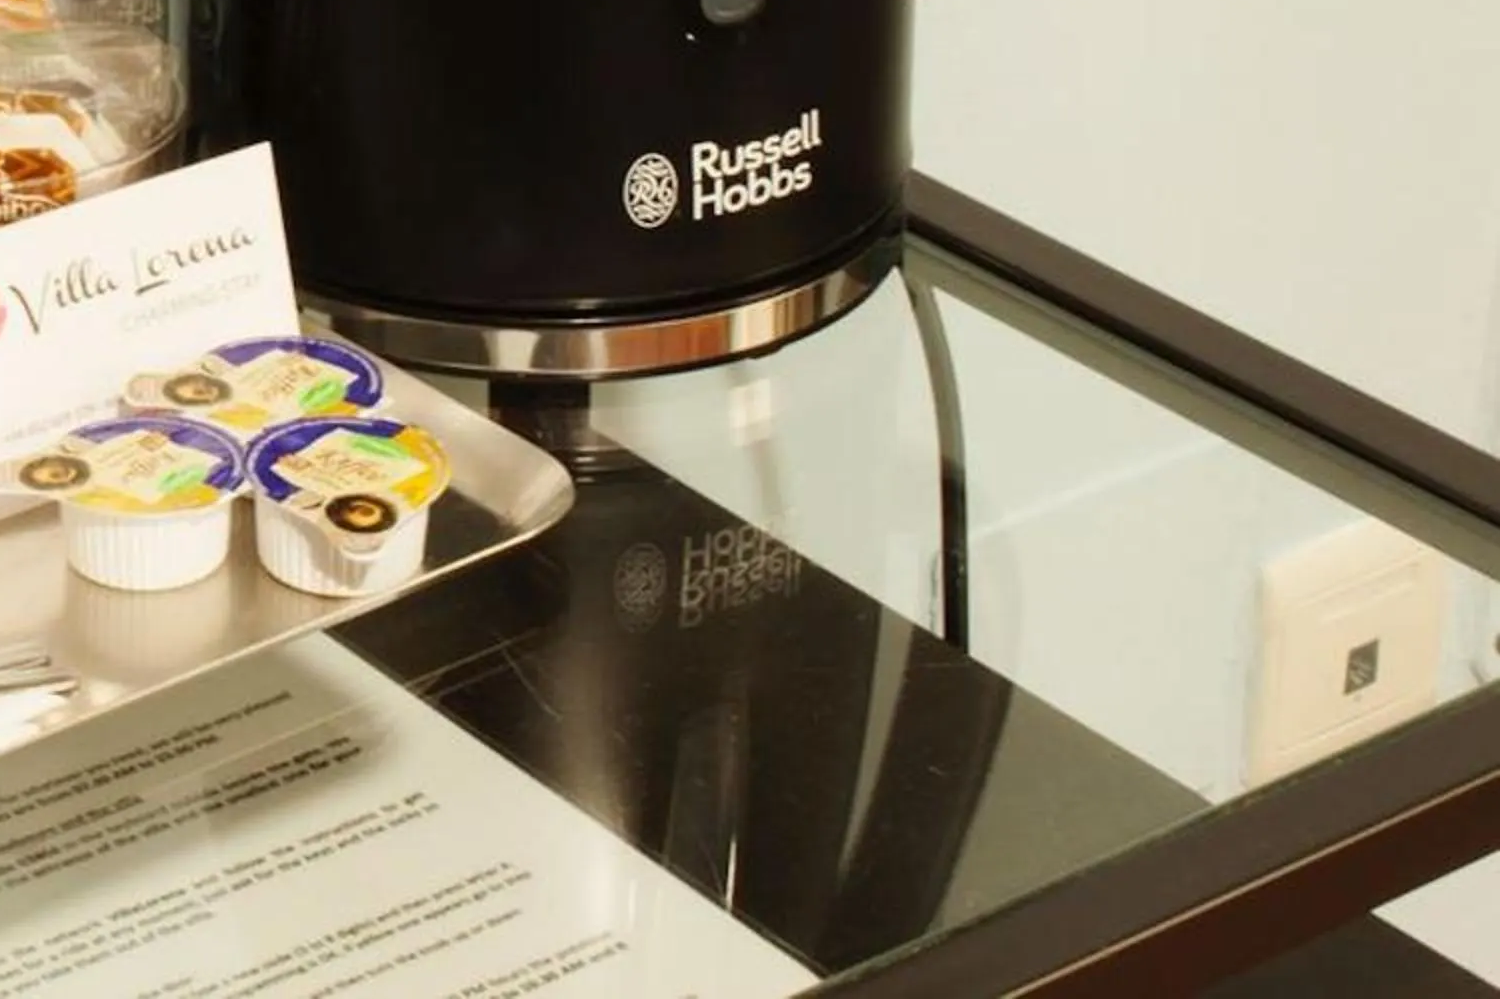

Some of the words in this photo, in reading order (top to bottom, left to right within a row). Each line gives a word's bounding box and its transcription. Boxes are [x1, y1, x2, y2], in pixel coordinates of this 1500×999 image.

[690, 107, 822, 182] Russell
[691, 161, 813, 221] Hobbs
[8, 254, 119, 335] Villa
[130, 224, 256, 297] Lorena
